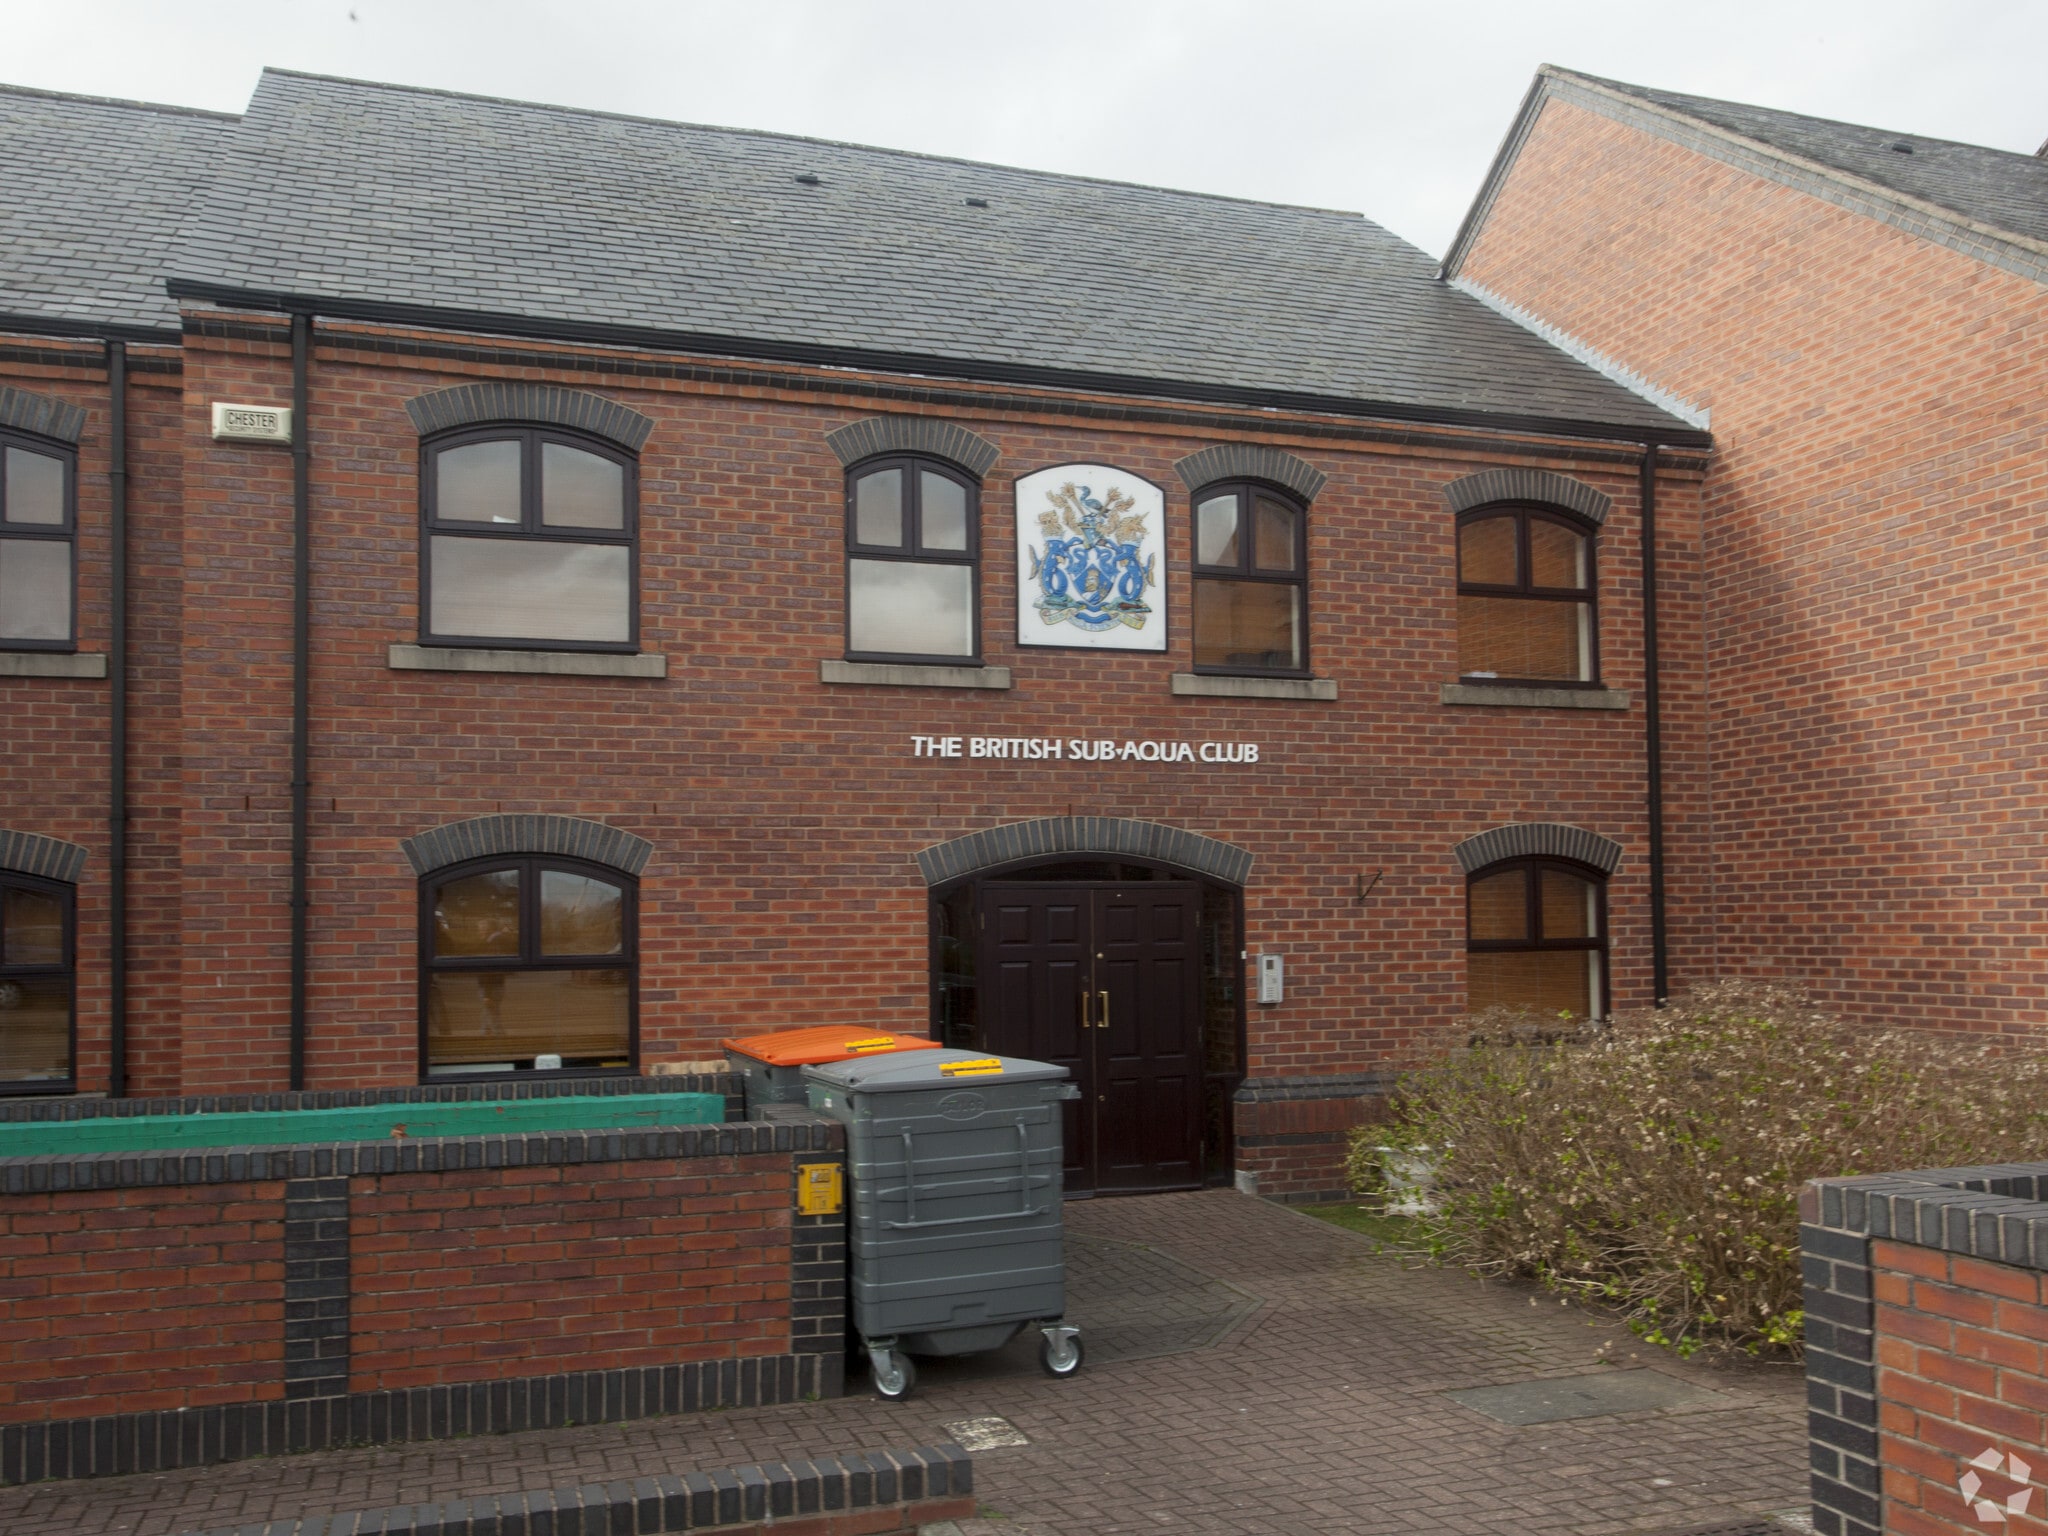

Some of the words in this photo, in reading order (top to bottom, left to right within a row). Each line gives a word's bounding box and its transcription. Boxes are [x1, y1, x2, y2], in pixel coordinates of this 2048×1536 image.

[228, 412, 276, 428] CHESTER
[910, 735, 963, 758] THE
[969, 737, 1062, 760] BRITISH
[1200, 742, 1260, 763] CLUB
